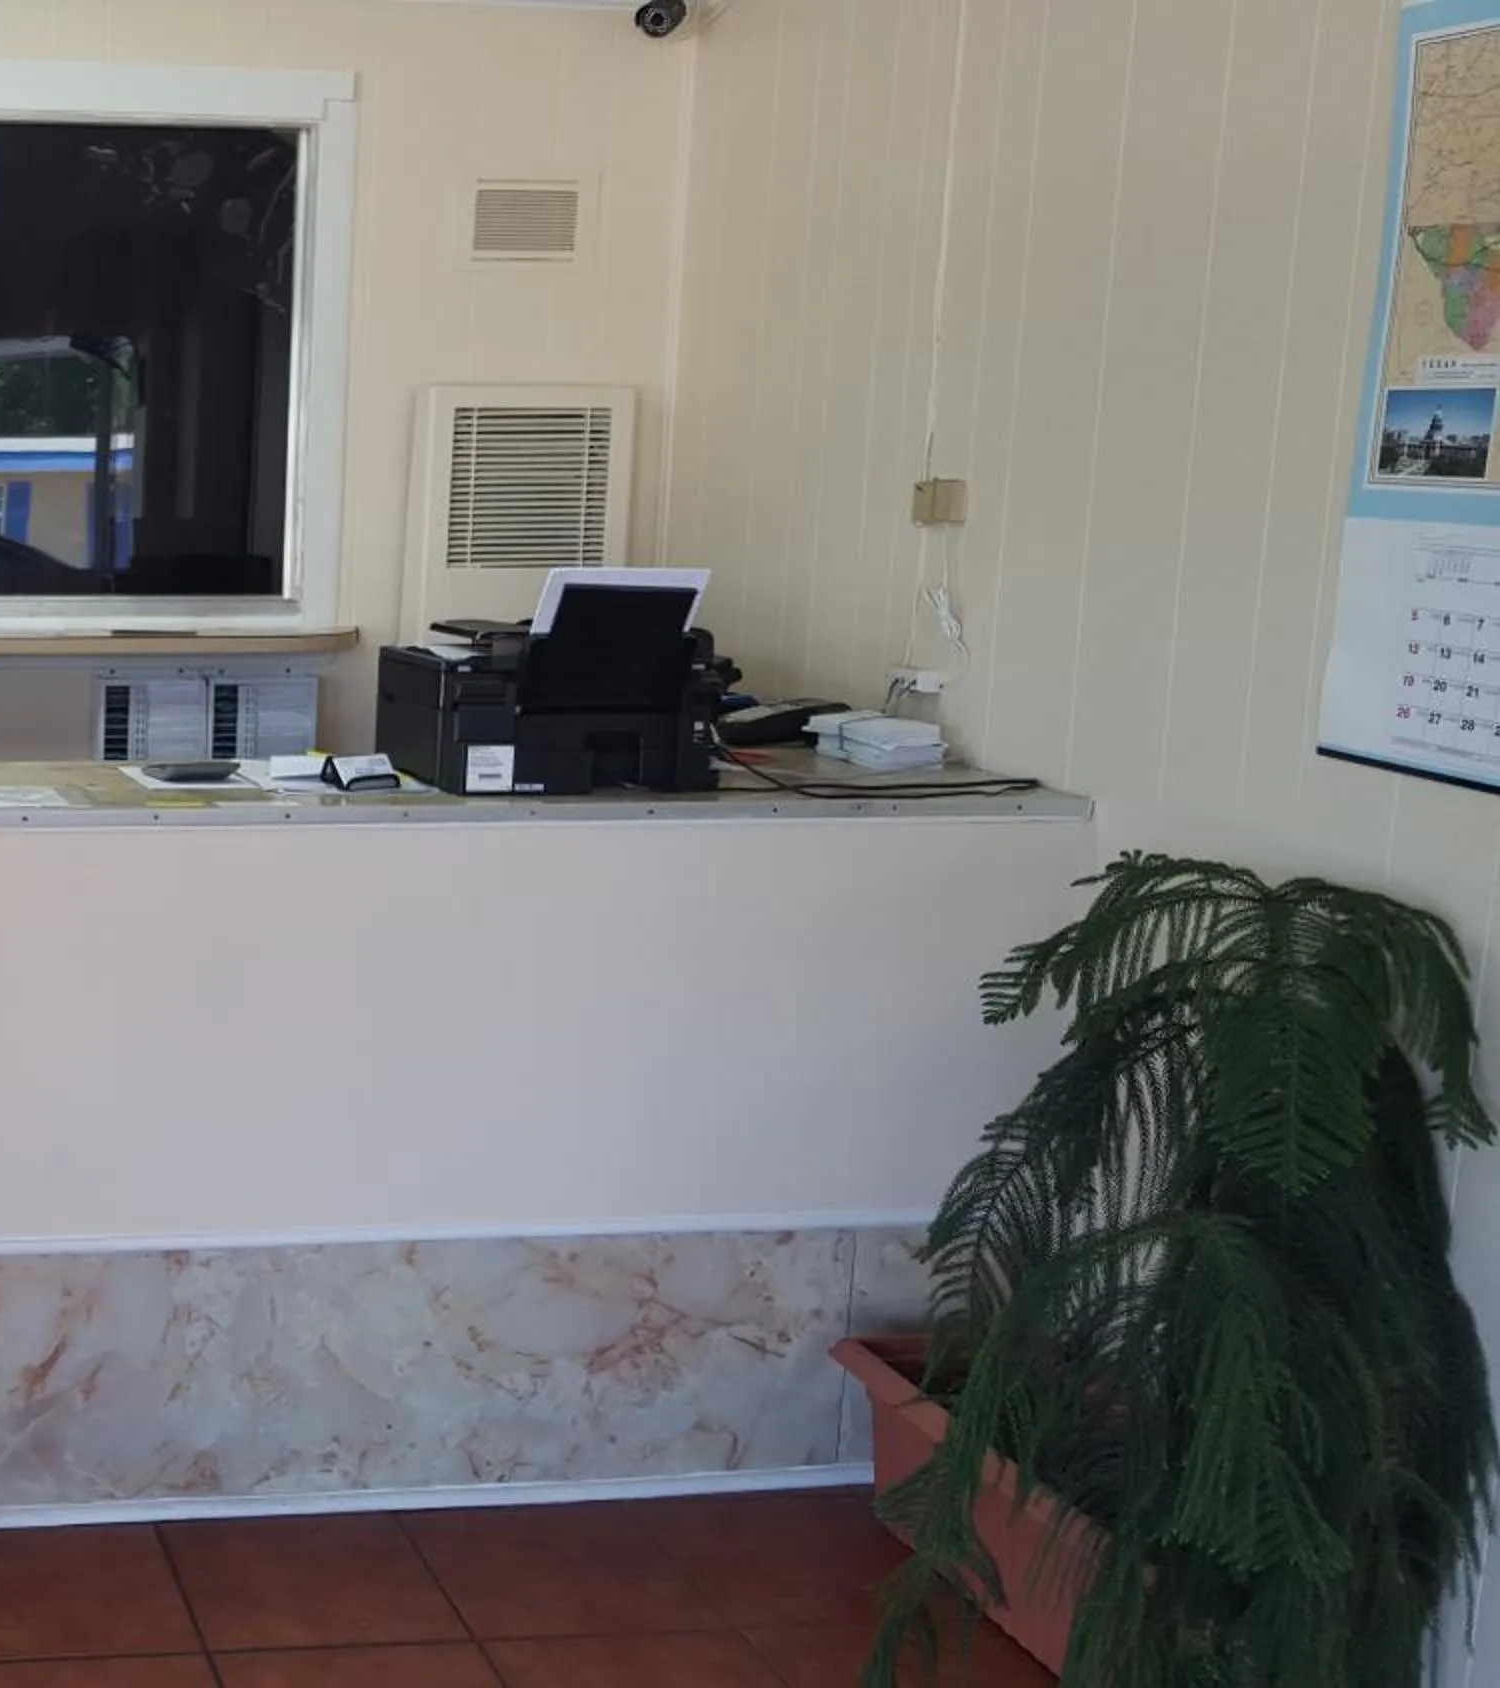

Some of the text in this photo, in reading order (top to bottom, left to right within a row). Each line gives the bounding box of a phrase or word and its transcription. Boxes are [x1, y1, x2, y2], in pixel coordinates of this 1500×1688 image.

[1408, 642, 1485, 664] 12 13 14
[1403, 674, 1479, 699] 19 20 21
[1396, 705, 1411, 719] 26
[1428, 711, 1442, 725] 27
[1460, 719, 1475, 732] 28
